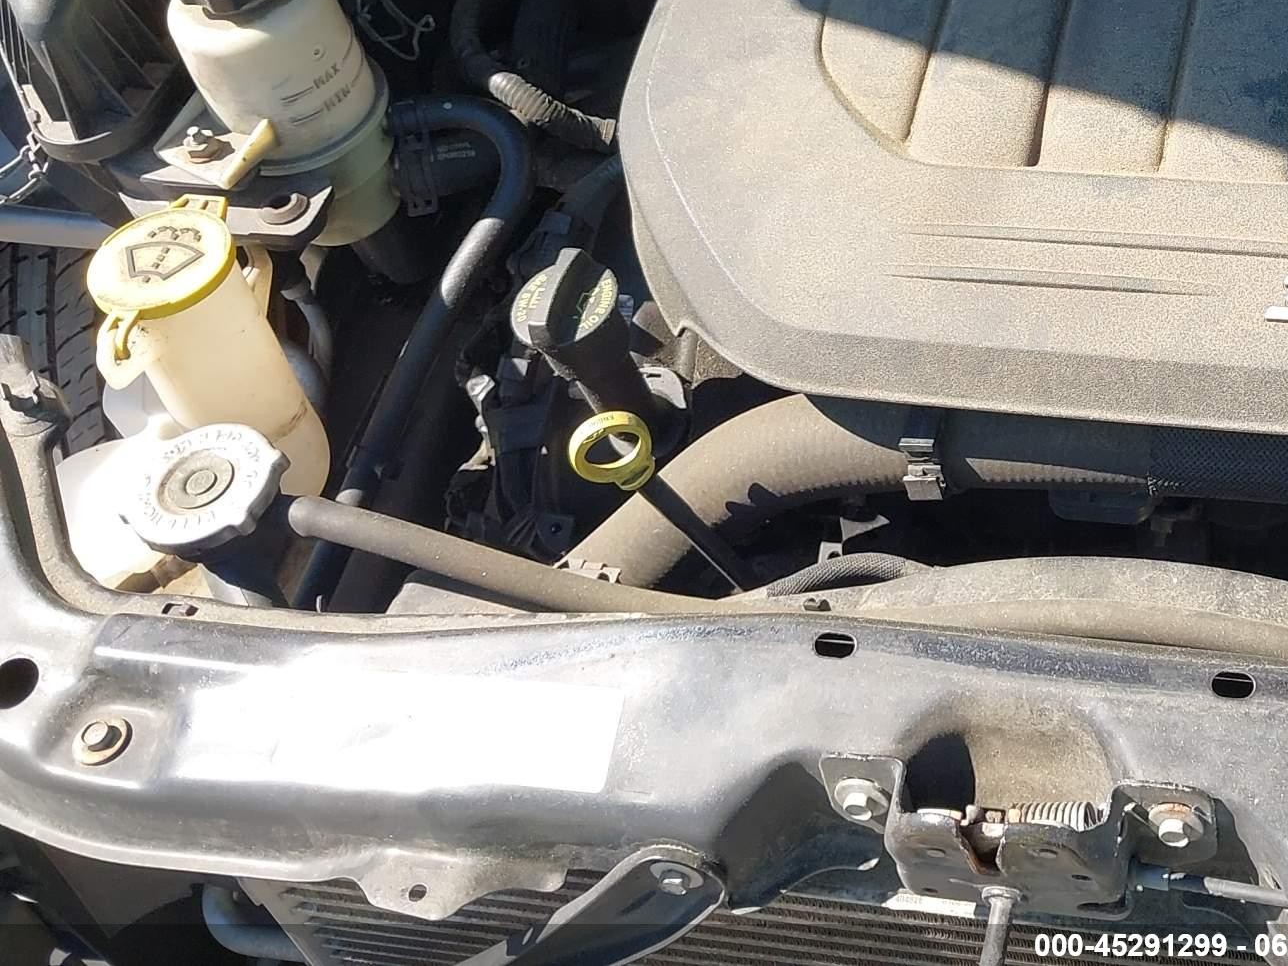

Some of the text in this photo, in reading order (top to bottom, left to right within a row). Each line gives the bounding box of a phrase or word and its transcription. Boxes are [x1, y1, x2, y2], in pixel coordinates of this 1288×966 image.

[313, 63, 341, 90] MAX
[324, 84, 352, 112] MIN
[582, 278, 613, 329] ENGINE OIL
